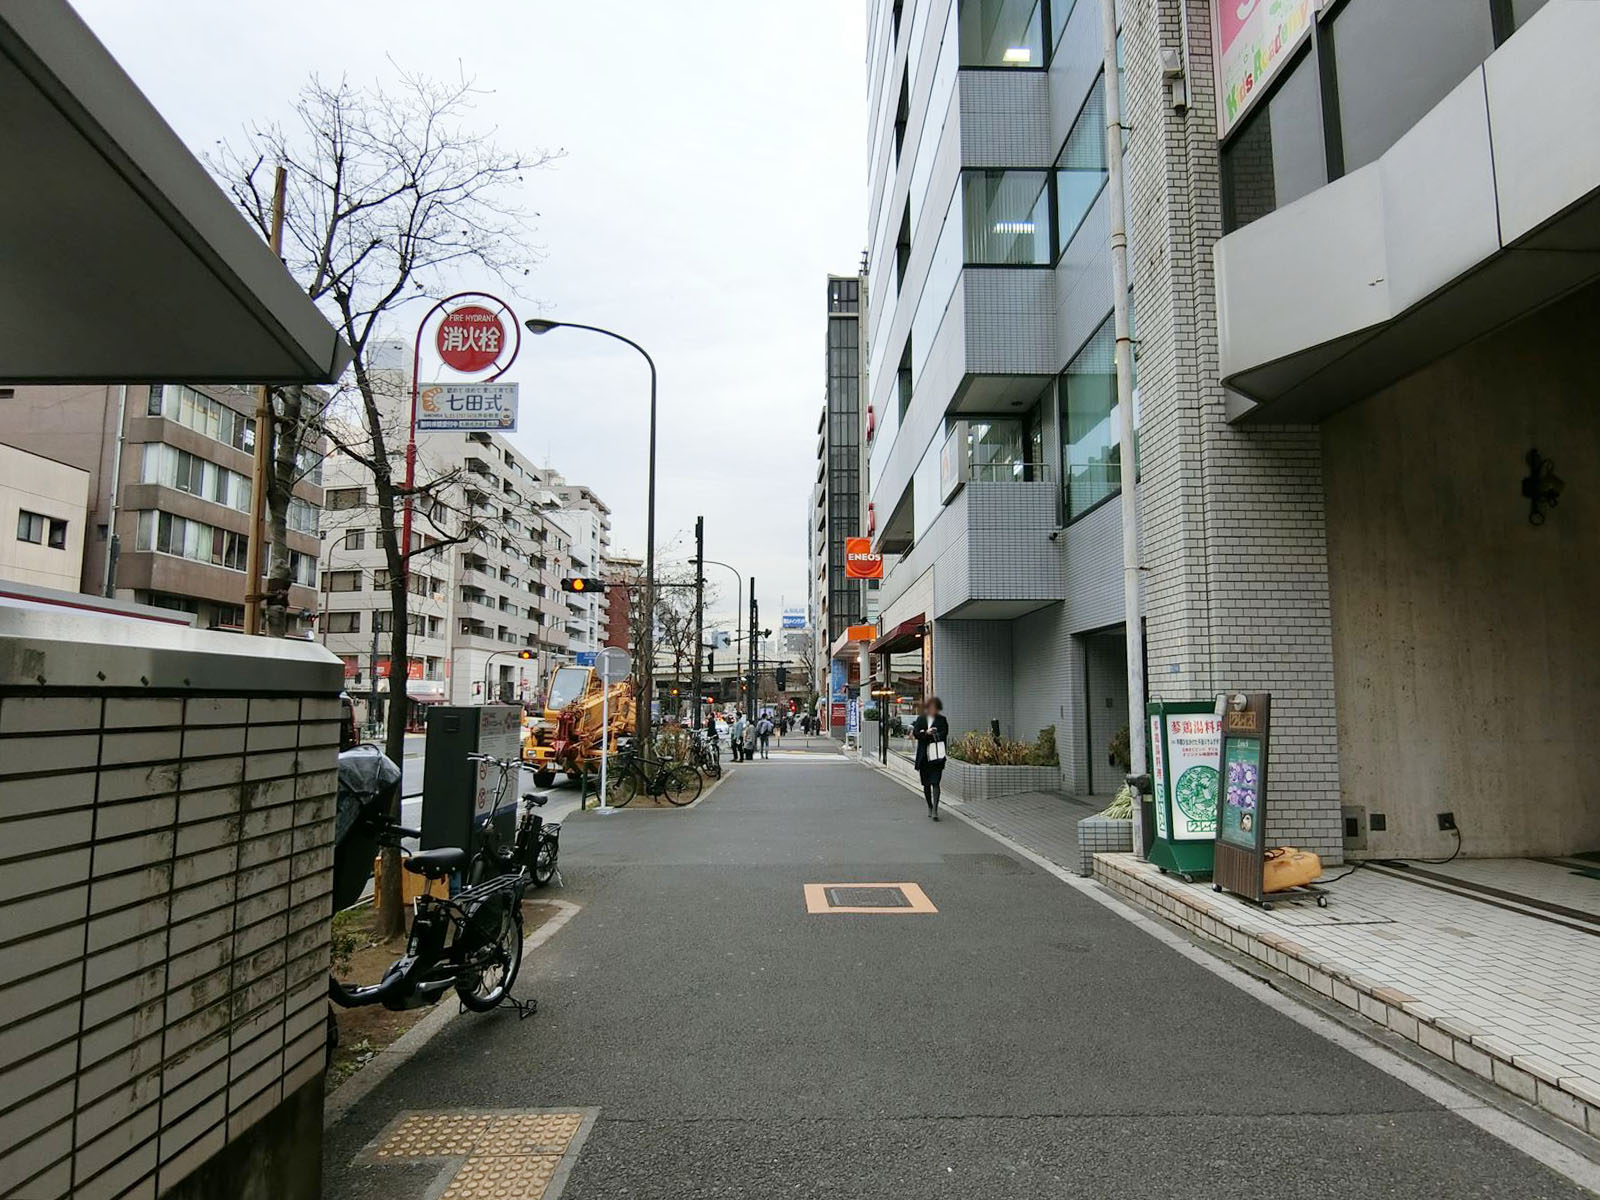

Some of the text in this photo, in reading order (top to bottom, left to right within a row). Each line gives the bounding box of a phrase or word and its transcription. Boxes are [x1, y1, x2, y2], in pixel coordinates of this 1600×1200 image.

[450, 314, 495, 322] FIRE HYDRANT
[443, 326, 501, 352] 消火栓
[445, 394, 503, 412] 七田式
[848, 553, 881, 561] ENEOS
